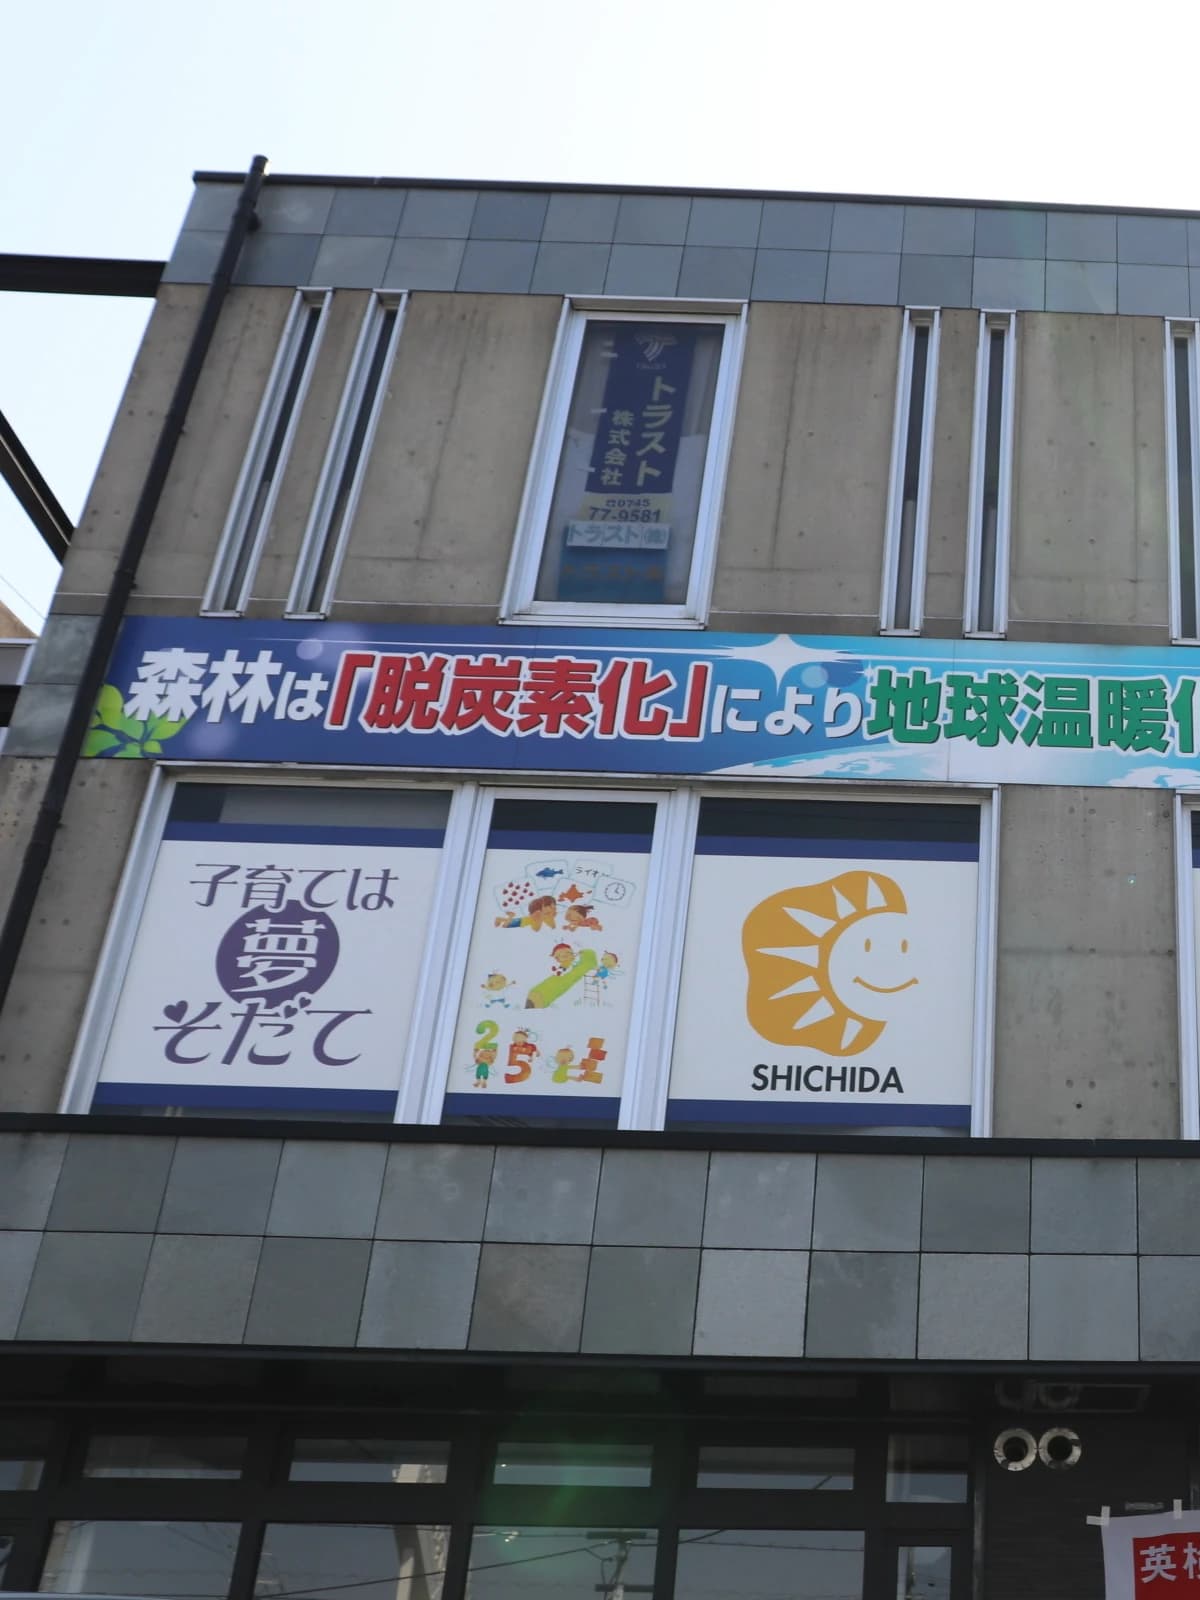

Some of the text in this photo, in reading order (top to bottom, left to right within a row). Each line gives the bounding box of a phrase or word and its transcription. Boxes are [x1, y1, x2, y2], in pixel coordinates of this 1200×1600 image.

[601, 409, 634, 487] 株式会社
[637, 376, 677, 487] トラスト
[589, 506, 661, 523] 77-9581
[189, 863, 399, 912] 子育ては
[230, 918, 326, 994] 夢
[154, 999, 373, 1066] そだて
[751, 1063, 904, 1093] SHICHIDA
